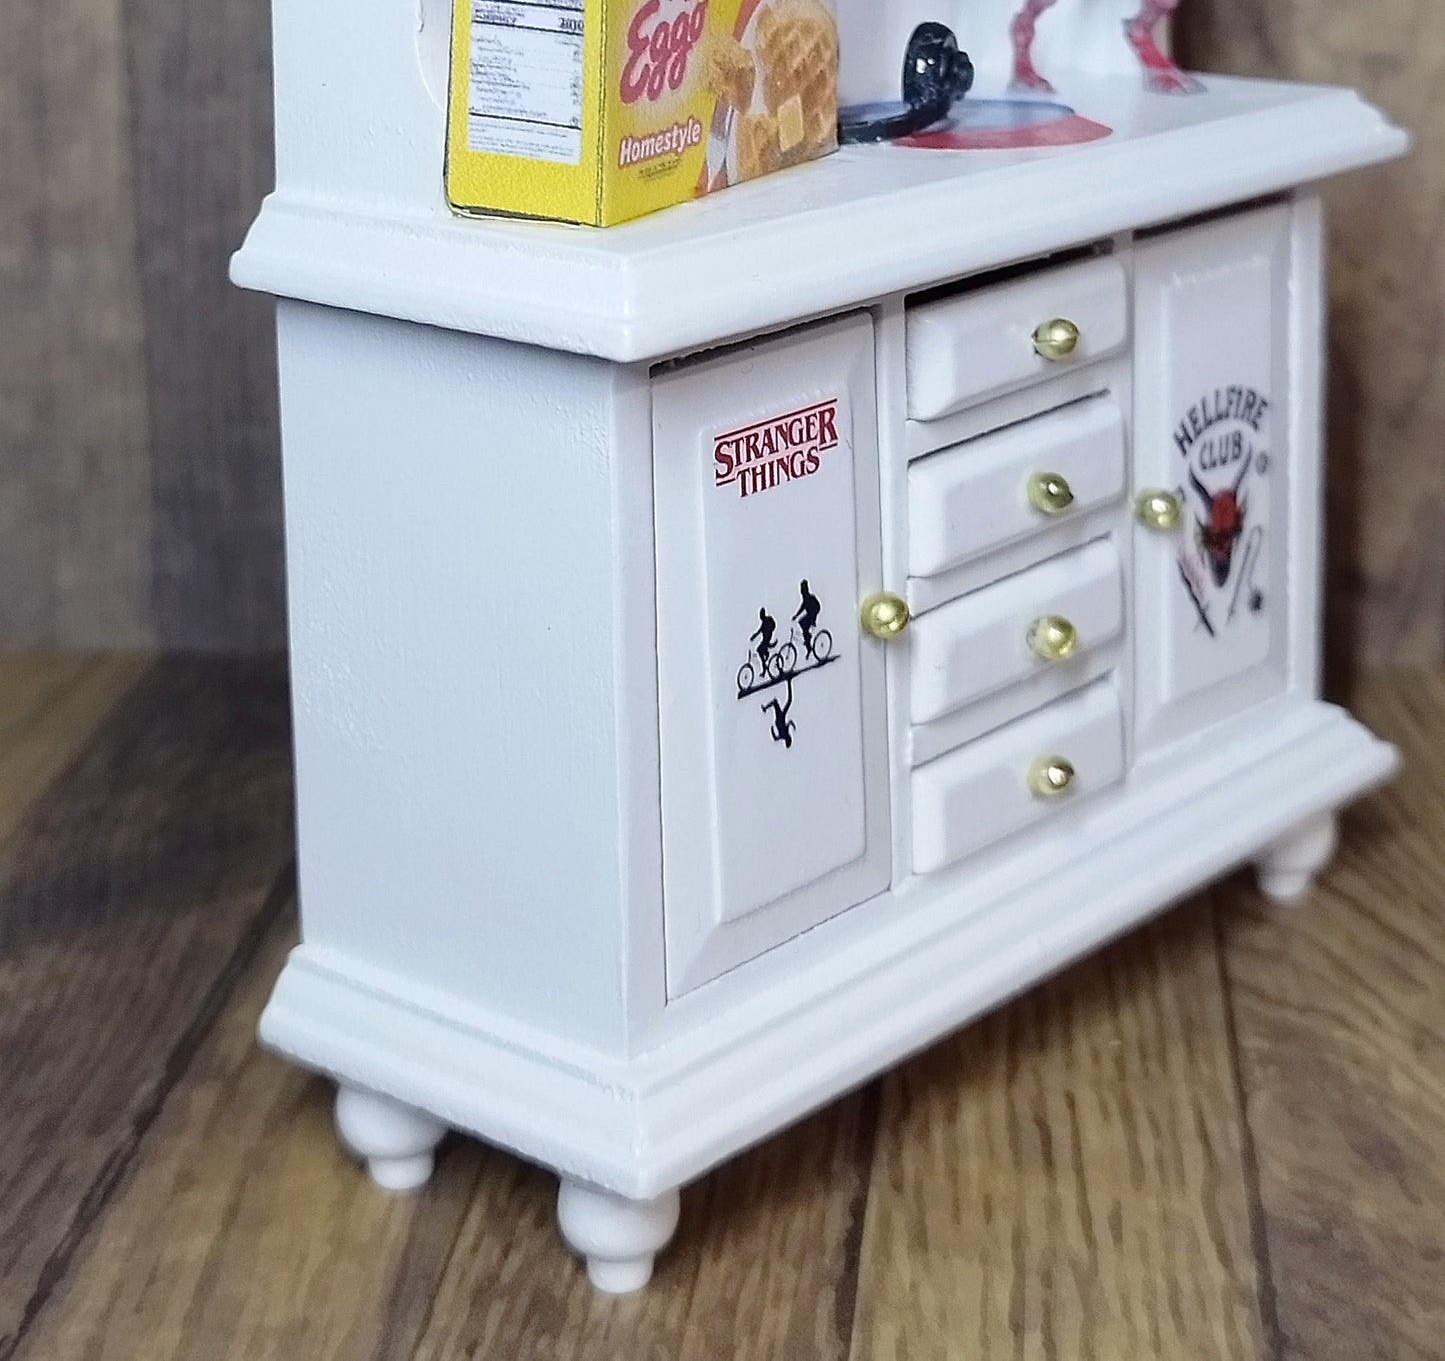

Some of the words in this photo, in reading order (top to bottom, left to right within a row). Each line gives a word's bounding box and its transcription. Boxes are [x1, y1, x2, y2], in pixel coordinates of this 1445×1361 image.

[619, 117, 702, 168] Homestyle
[714, 407, 839, 481] STRANGER
[1173, 384, 1268, 458] HELLFIRE
[736, 446, 821, 498] THINGS
[1199, 430, 1243, 470] CLUB
